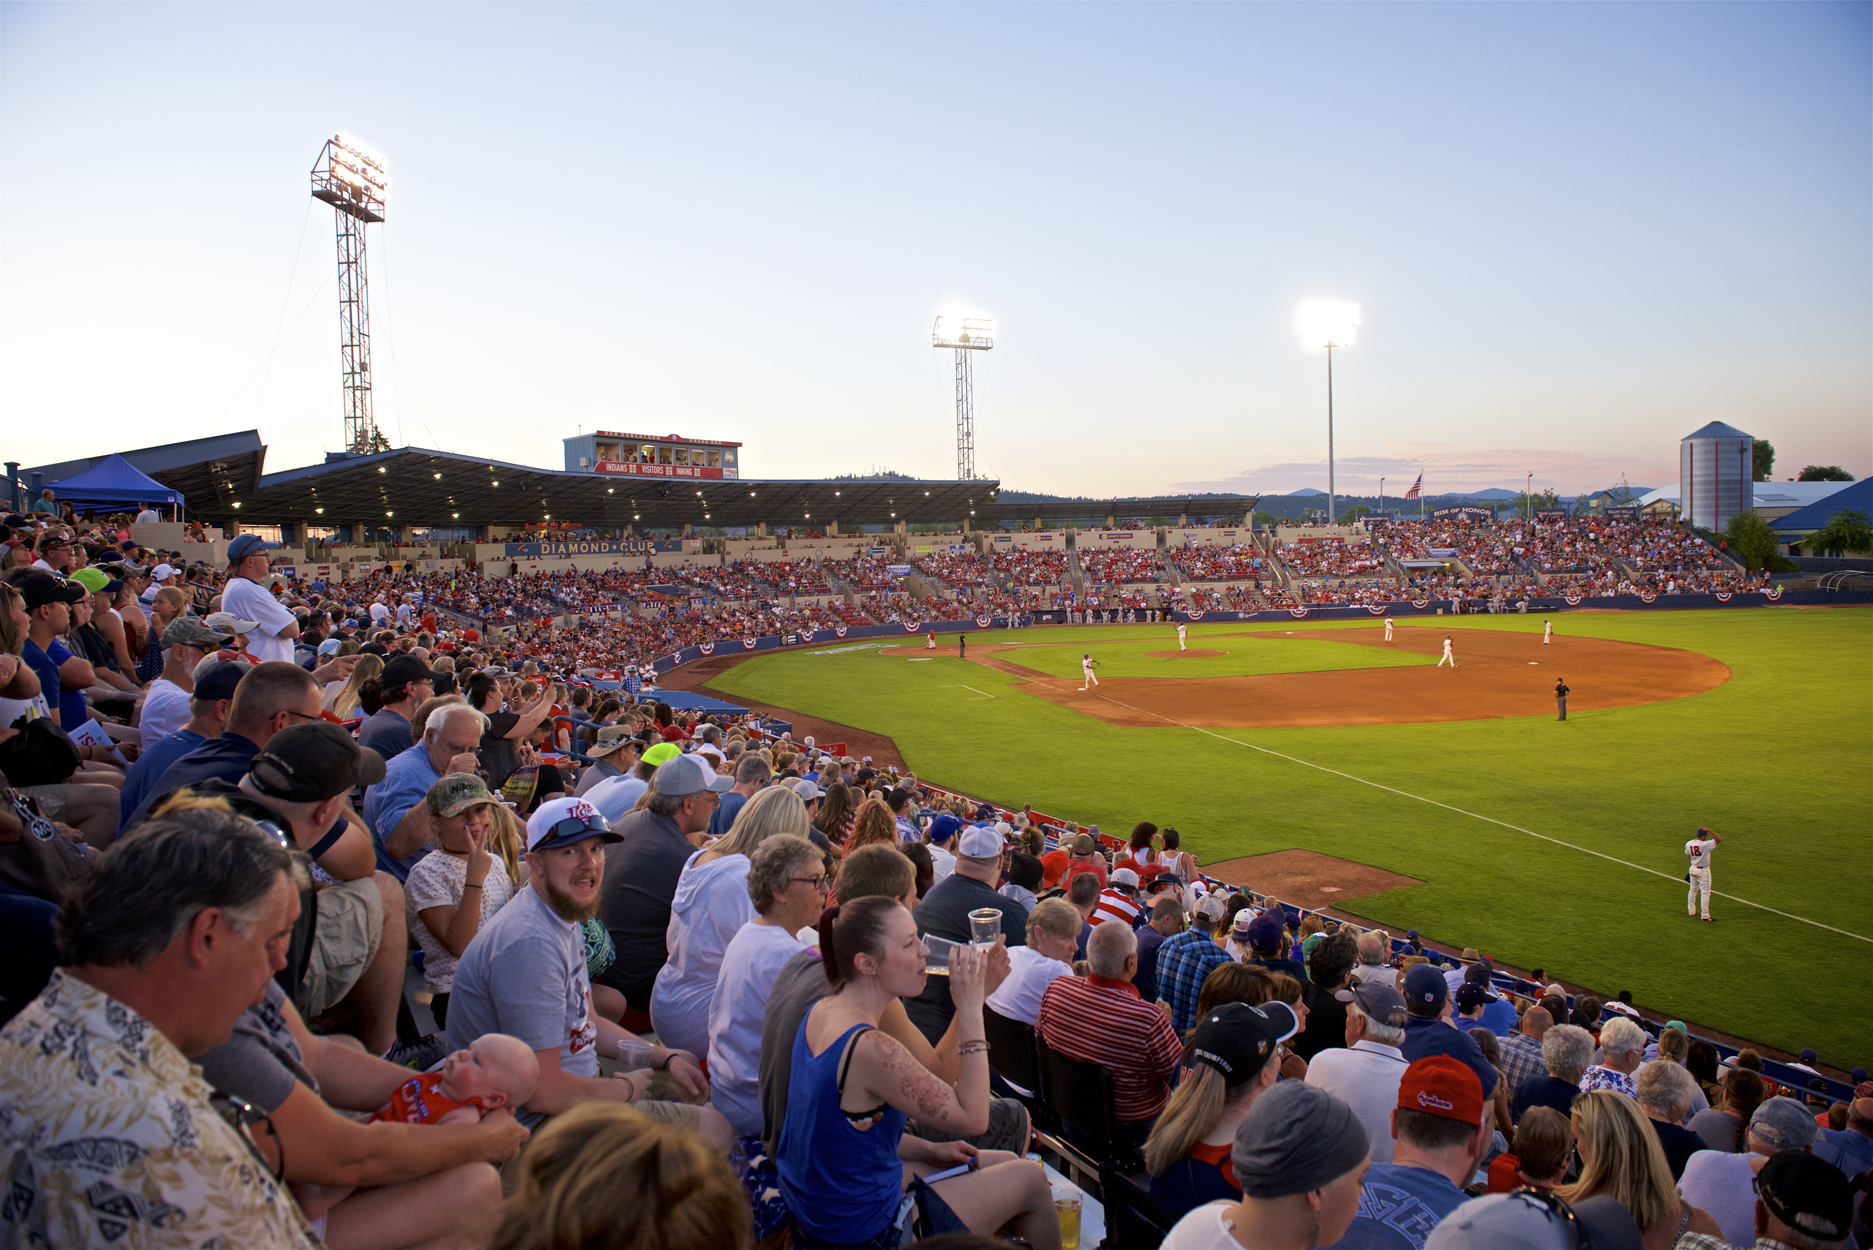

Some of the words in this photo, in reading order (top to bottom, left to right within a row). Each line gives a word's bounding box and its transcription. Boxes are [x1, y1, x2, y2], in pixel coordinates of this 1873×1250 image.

[620, 432, 661, 440] ROBERTSON
[606, 463, 628, 472] INDIANS
[642, 465, 664, 474] VISITORS
[676, 467, 693, 476] INNING
[1433, 508, 1449, 517] RIM
[1462, 506, 1492, 516] HONOR
[541, 542, 609, 554] DIAMOND
[451, 782, 480, 794] Nikon
[1689, 845, 1702, 857] 18
[1417, 1091, 1454, 1110] Spokane
